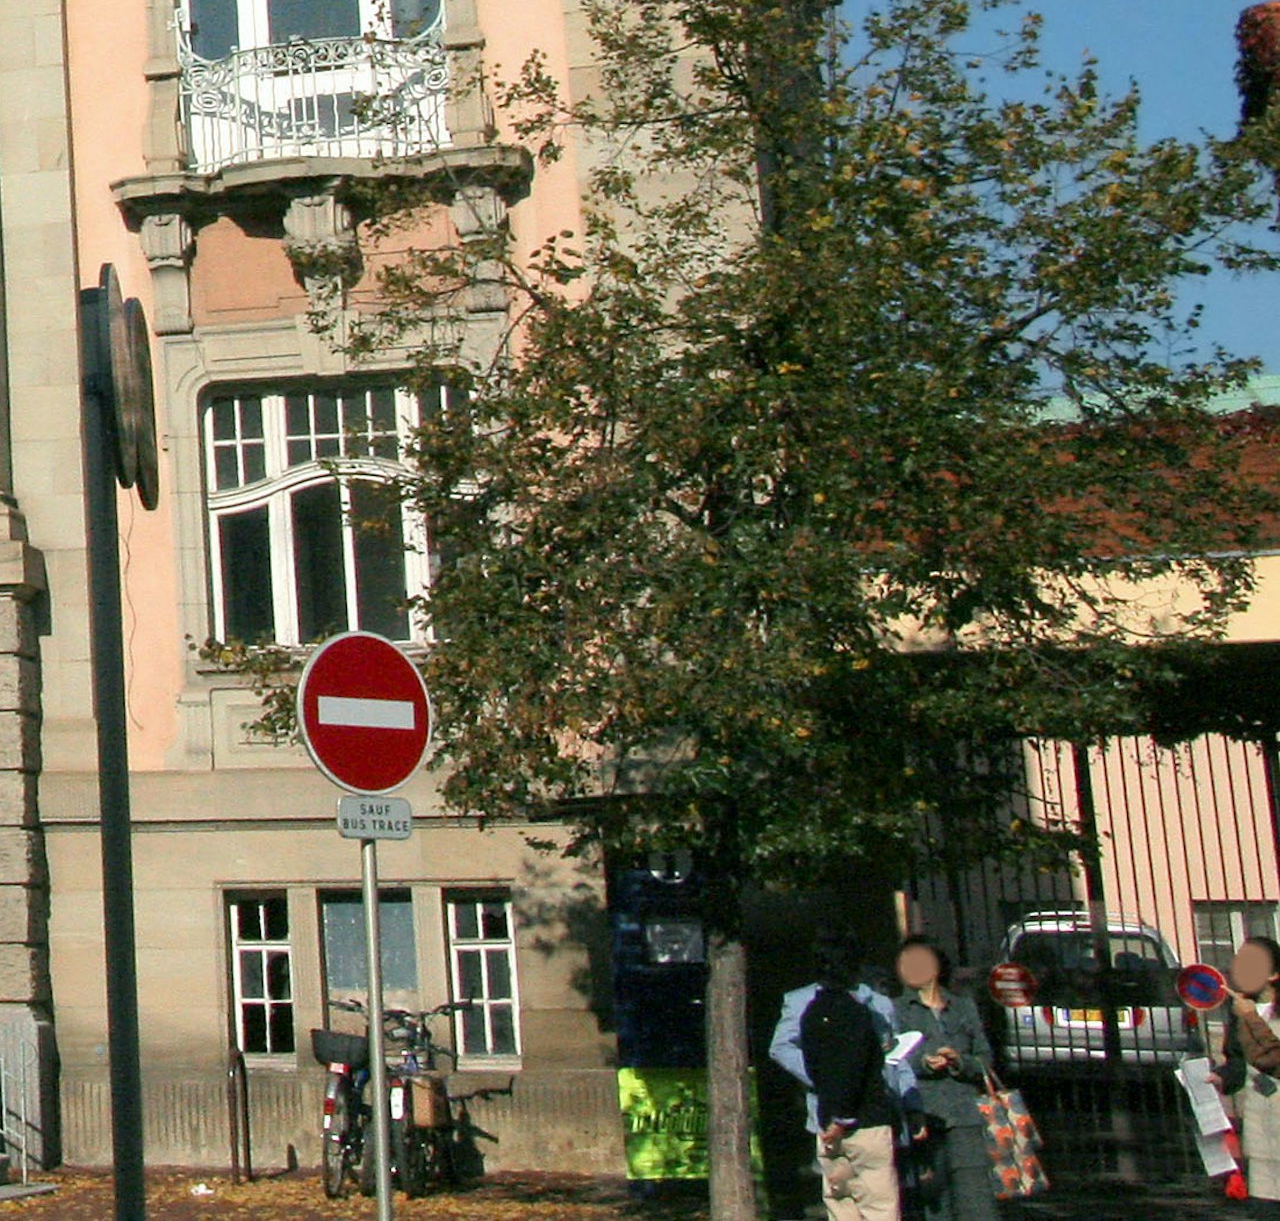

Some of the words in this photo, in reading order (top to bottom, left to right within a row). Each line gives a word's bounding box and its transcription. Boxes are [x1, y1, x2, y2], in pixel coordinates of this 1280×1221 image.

[360, 803, 390, 816] SAUF
[343, 818, 366, 830] BUS
[372, 819, 409, 832] TRACE
